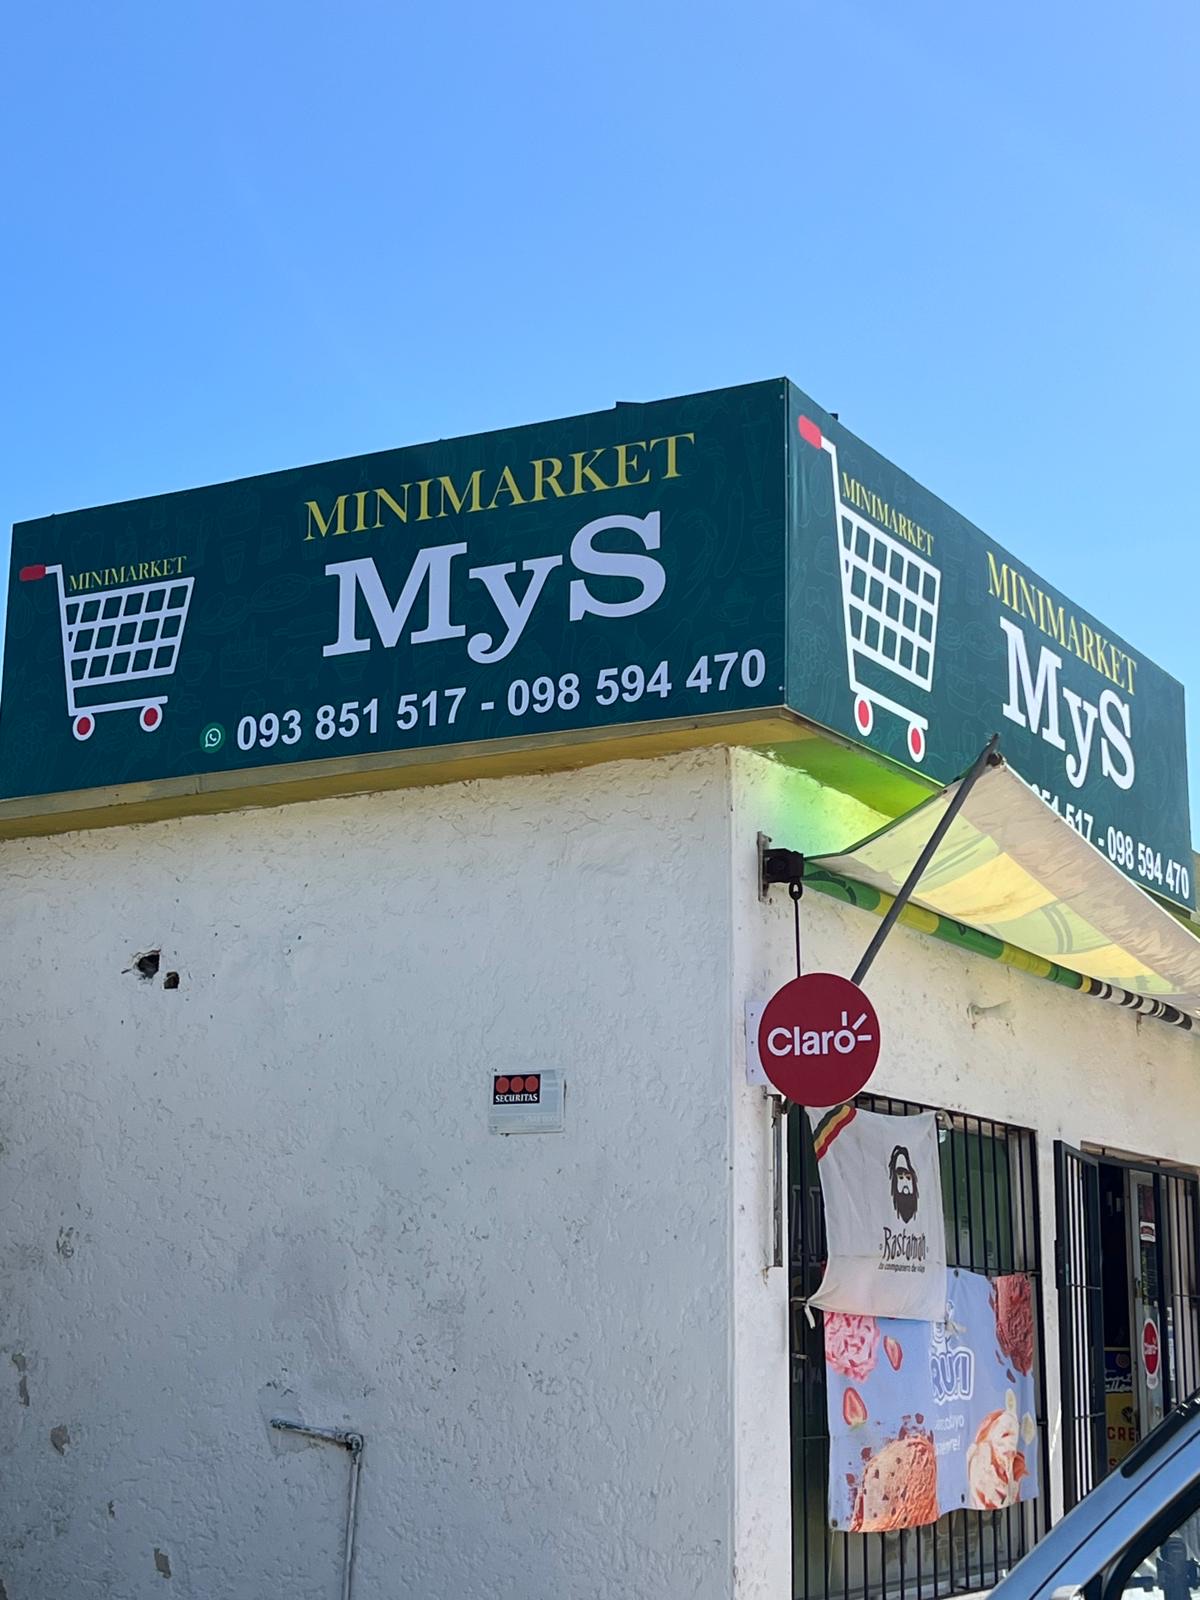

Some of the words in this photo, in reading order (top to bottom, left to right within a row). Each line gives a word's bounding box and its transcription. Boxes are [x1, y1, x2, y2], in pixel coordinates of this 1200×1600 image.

[303, 432, 695, 541] MINIMARKET
[842, 471, 935, 557] MINIMARKET
[69, 556, 187, 591] MINIMARKET
[322, 510, 667, 664] MyS
[987, 551, 1138, 696] MINIMARKET
[236, 709, 302, 751] 093
[315, 698, 378, 740] 851
[396, 687, 467, 730] 517
[507, 673, 580, 716] 098
[596, 660, 672, 706] 594
[686, 649, 766, 694] 470
[1000, 616, 1136, 790] MyS
[1107, 826, 1134, 870] 098
[1138, 842, 1163, 885] 594
[1165, 859, 1190, 900] 470
[767, 1026, 856, 1057] Claro
[495, 1093, 538, 1103] SECURITAS
